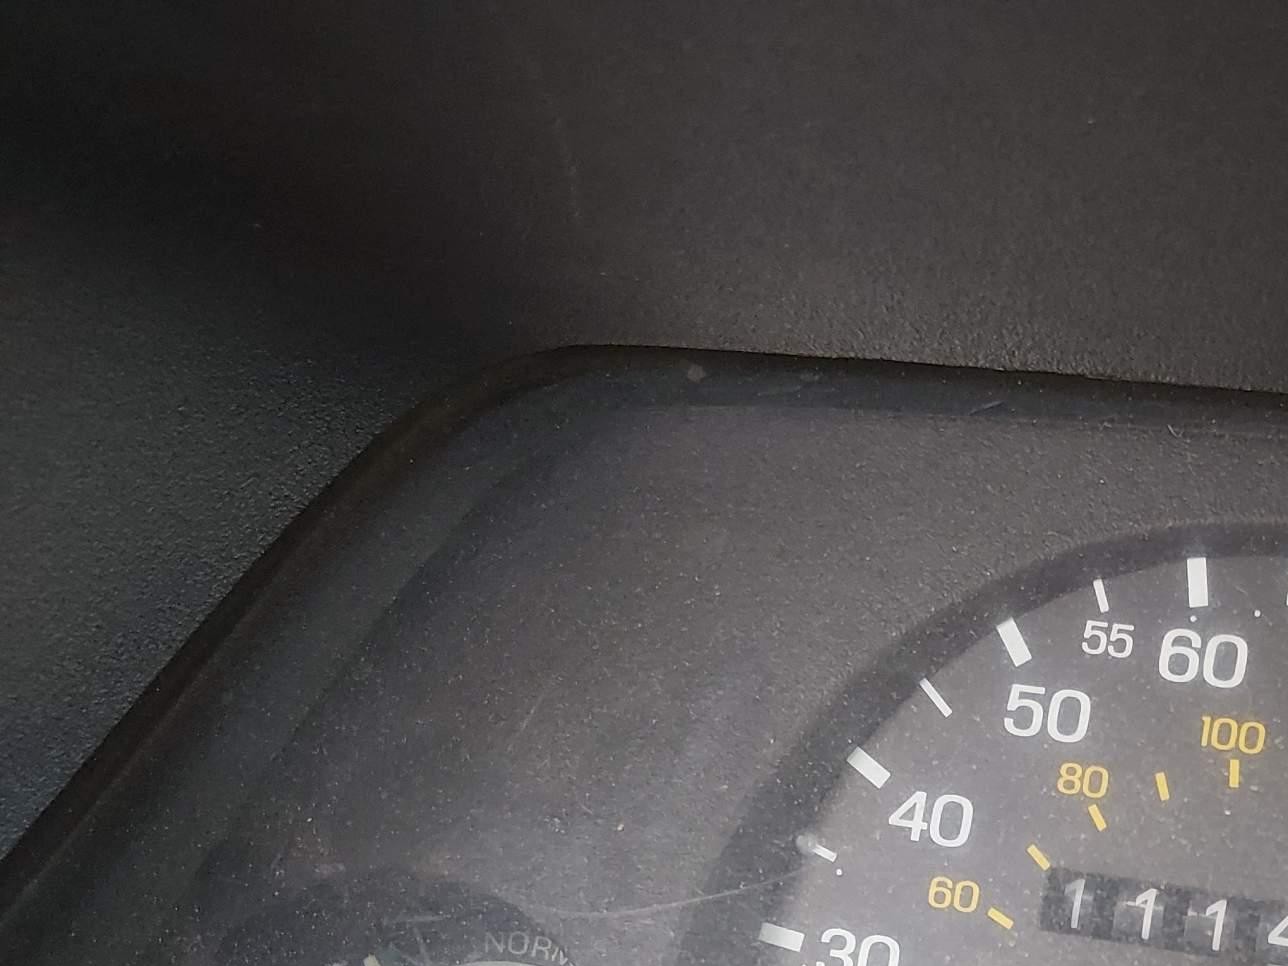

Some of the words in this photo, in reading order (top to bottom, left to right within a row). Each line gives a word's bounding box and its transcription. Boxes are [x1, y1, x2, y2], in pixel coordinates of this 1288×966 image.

[1082, 621, 1135, 659] 55
[1158, 628, 1249, 689] 60
[1003, 684, 1092, 743] 50
[1201, 716, 1266, 755] 100
[1056, 762, 1110, 799] 80
[888, 790, 975, 848] 40
[927, 876, 980, 914] 60
